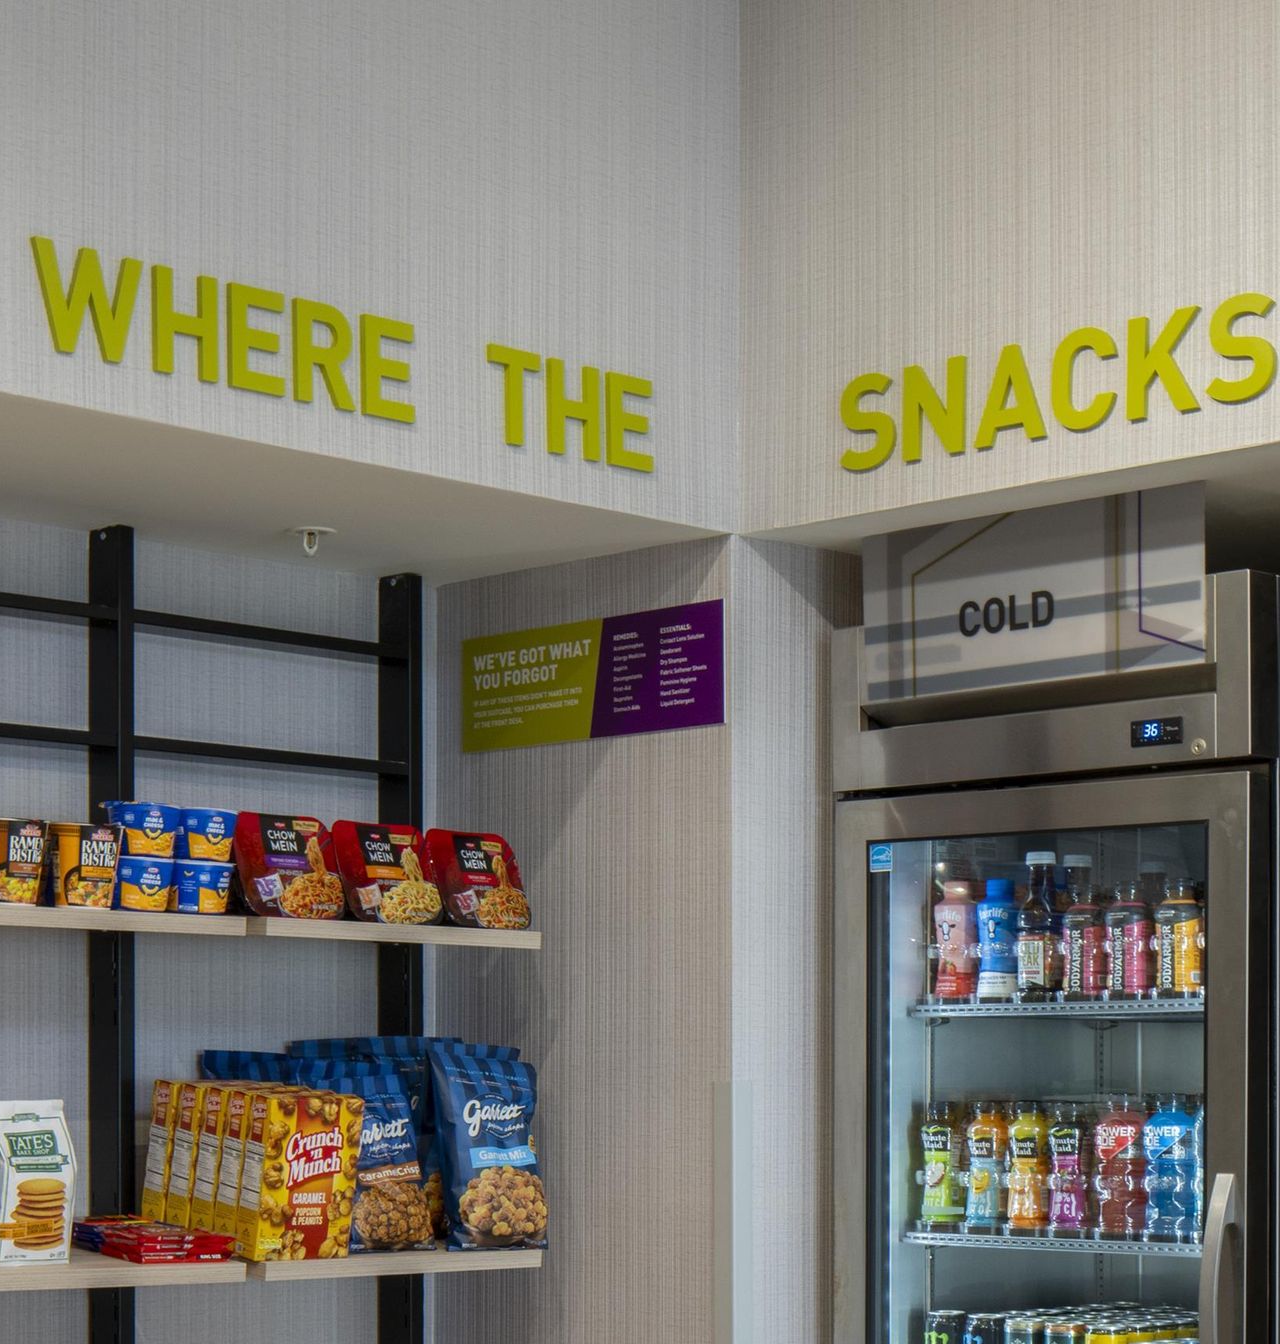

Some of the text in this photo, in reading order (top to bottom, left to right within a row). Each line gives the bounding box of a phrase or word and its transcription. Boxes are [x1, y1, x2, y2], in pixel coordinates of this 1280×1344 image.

[29, 235, 417, 425] WHERE
[486, 342, 655, 474] THE
[839, 291, 1277, 472] SNACKS
[958, 590, 1056, 638] COLD
[473, 639, 592, 672] WE'VE GOT WHAT
[473, 664, 559, 692] YOU FORGOT
[1143, 722, 1159, 738] 36
[9, 835, 45, 853] RAMEN
[266, 830, 297, 841] CHOW
[81, 839, 117, 857] RAMEN
[270, 839, 298, 852] MEIN
[365, 840, 391, 852] CHOW
[369, 850, 395, 863] MEIN
[460, 849, 485, 860] CHOW
[463, 859, 488, 870] MEIN
[463, 1100, 526, 1137] Garrett
[9, 1134, 54, 1151] TATE'S
[286, 1127, 343, 1161] Crunch
[286, 1155, 341, 1188] Munch
[292, 1192, 327, 1205] CARAMEL
[295, 1207, 322, 1218] POPCORN
[297, 1216, 323, 1226] PEANUTS
